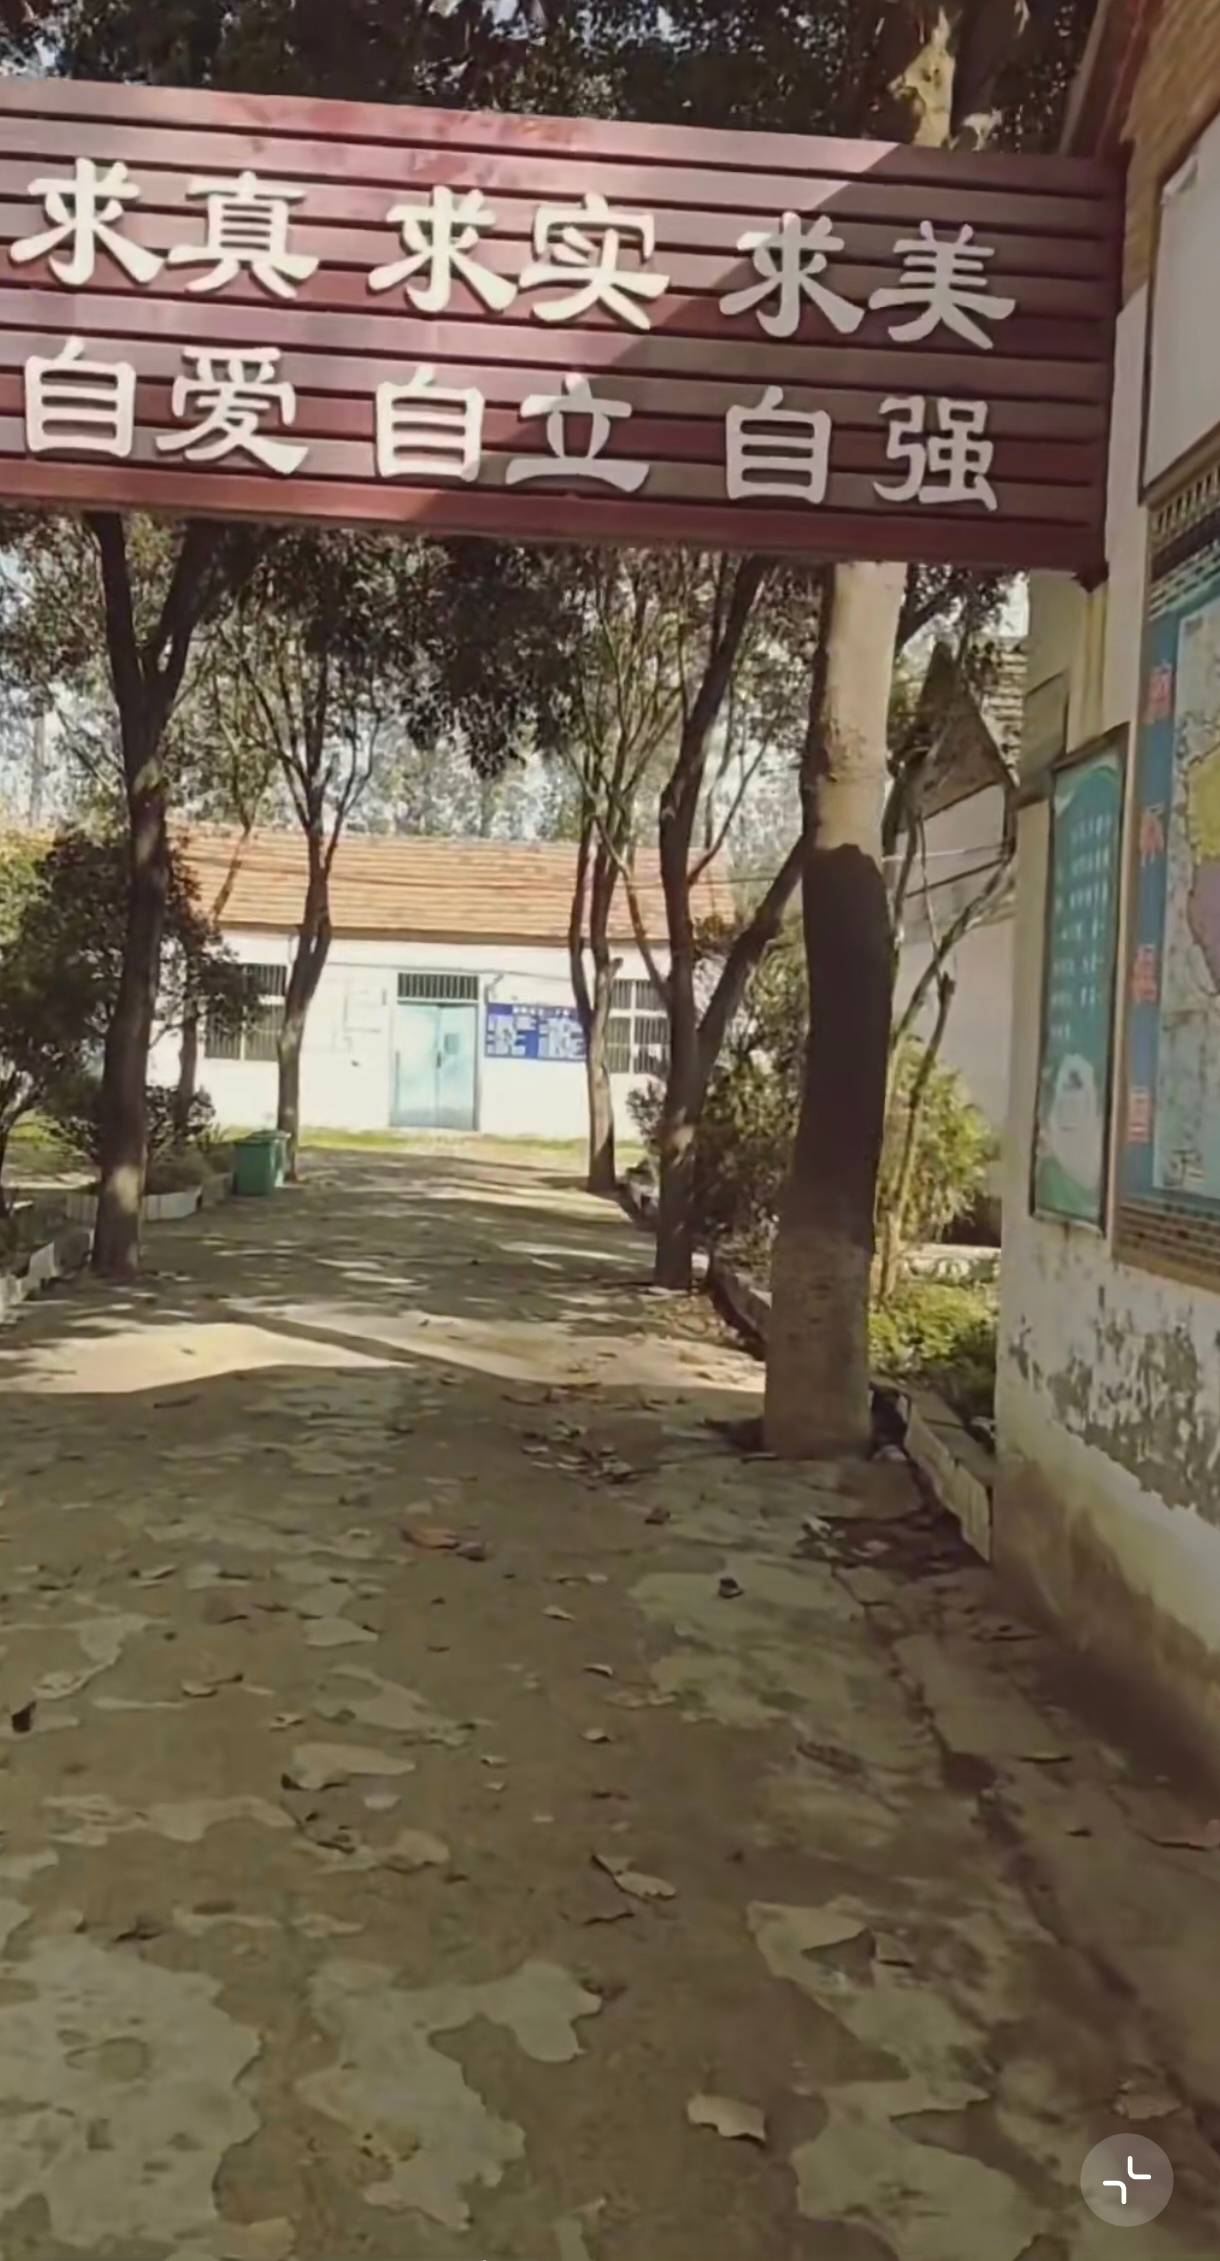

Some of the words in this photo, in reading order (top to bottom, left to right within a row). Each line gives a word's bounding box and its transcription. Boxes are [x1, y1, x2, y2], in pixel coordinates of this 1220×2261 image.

[8, 157, 320, 299] 求真
[367, 185, 670, 330] 求实
[719, 211, 1016, 350] 求美
[24, 335, 309, 474] 自爱
[376, 364, 650, 493] 自立
[726, 385, 998, 511] 自强
